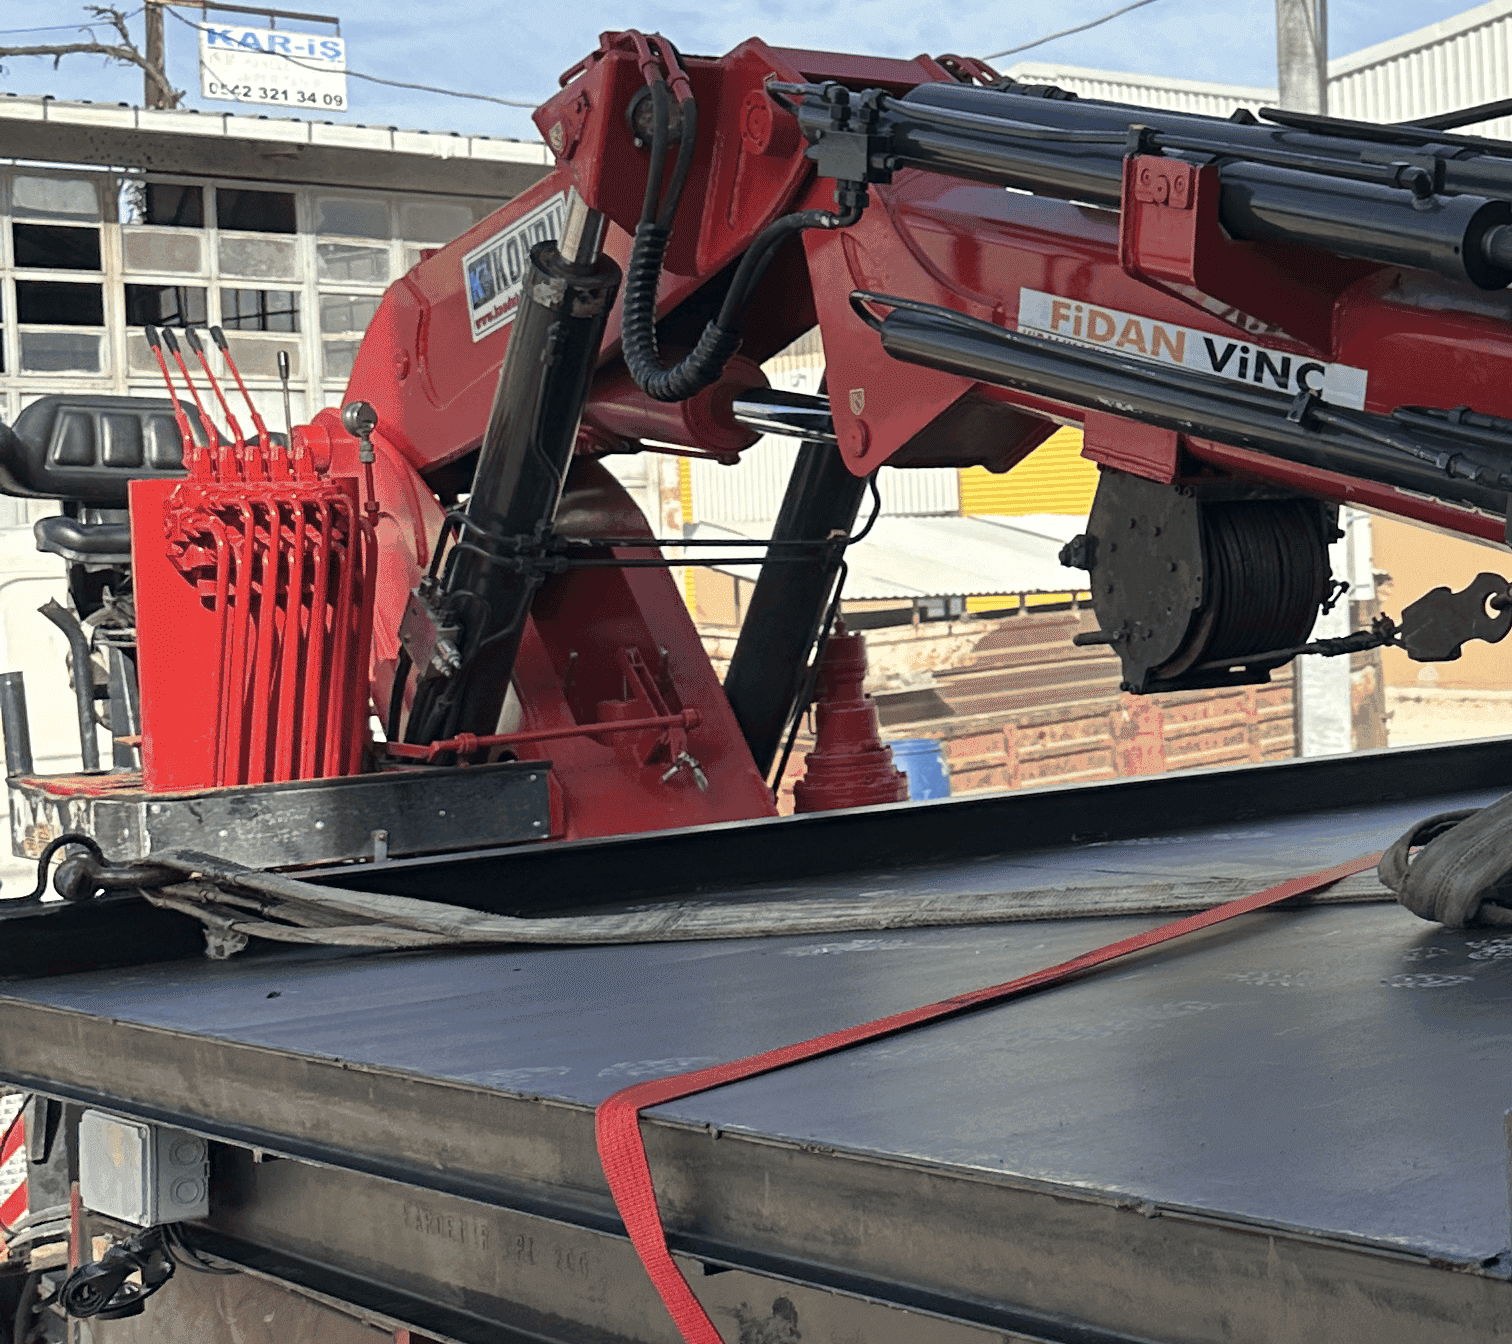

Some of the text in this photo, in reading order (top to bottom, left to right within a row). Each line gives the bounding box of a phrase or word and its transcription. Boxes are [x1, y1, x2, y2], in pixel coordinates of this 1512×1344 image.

[258, 87, 288, 102] 321
[297, 90, 317, 104] 34
[323, 94, 343, 107] 09
